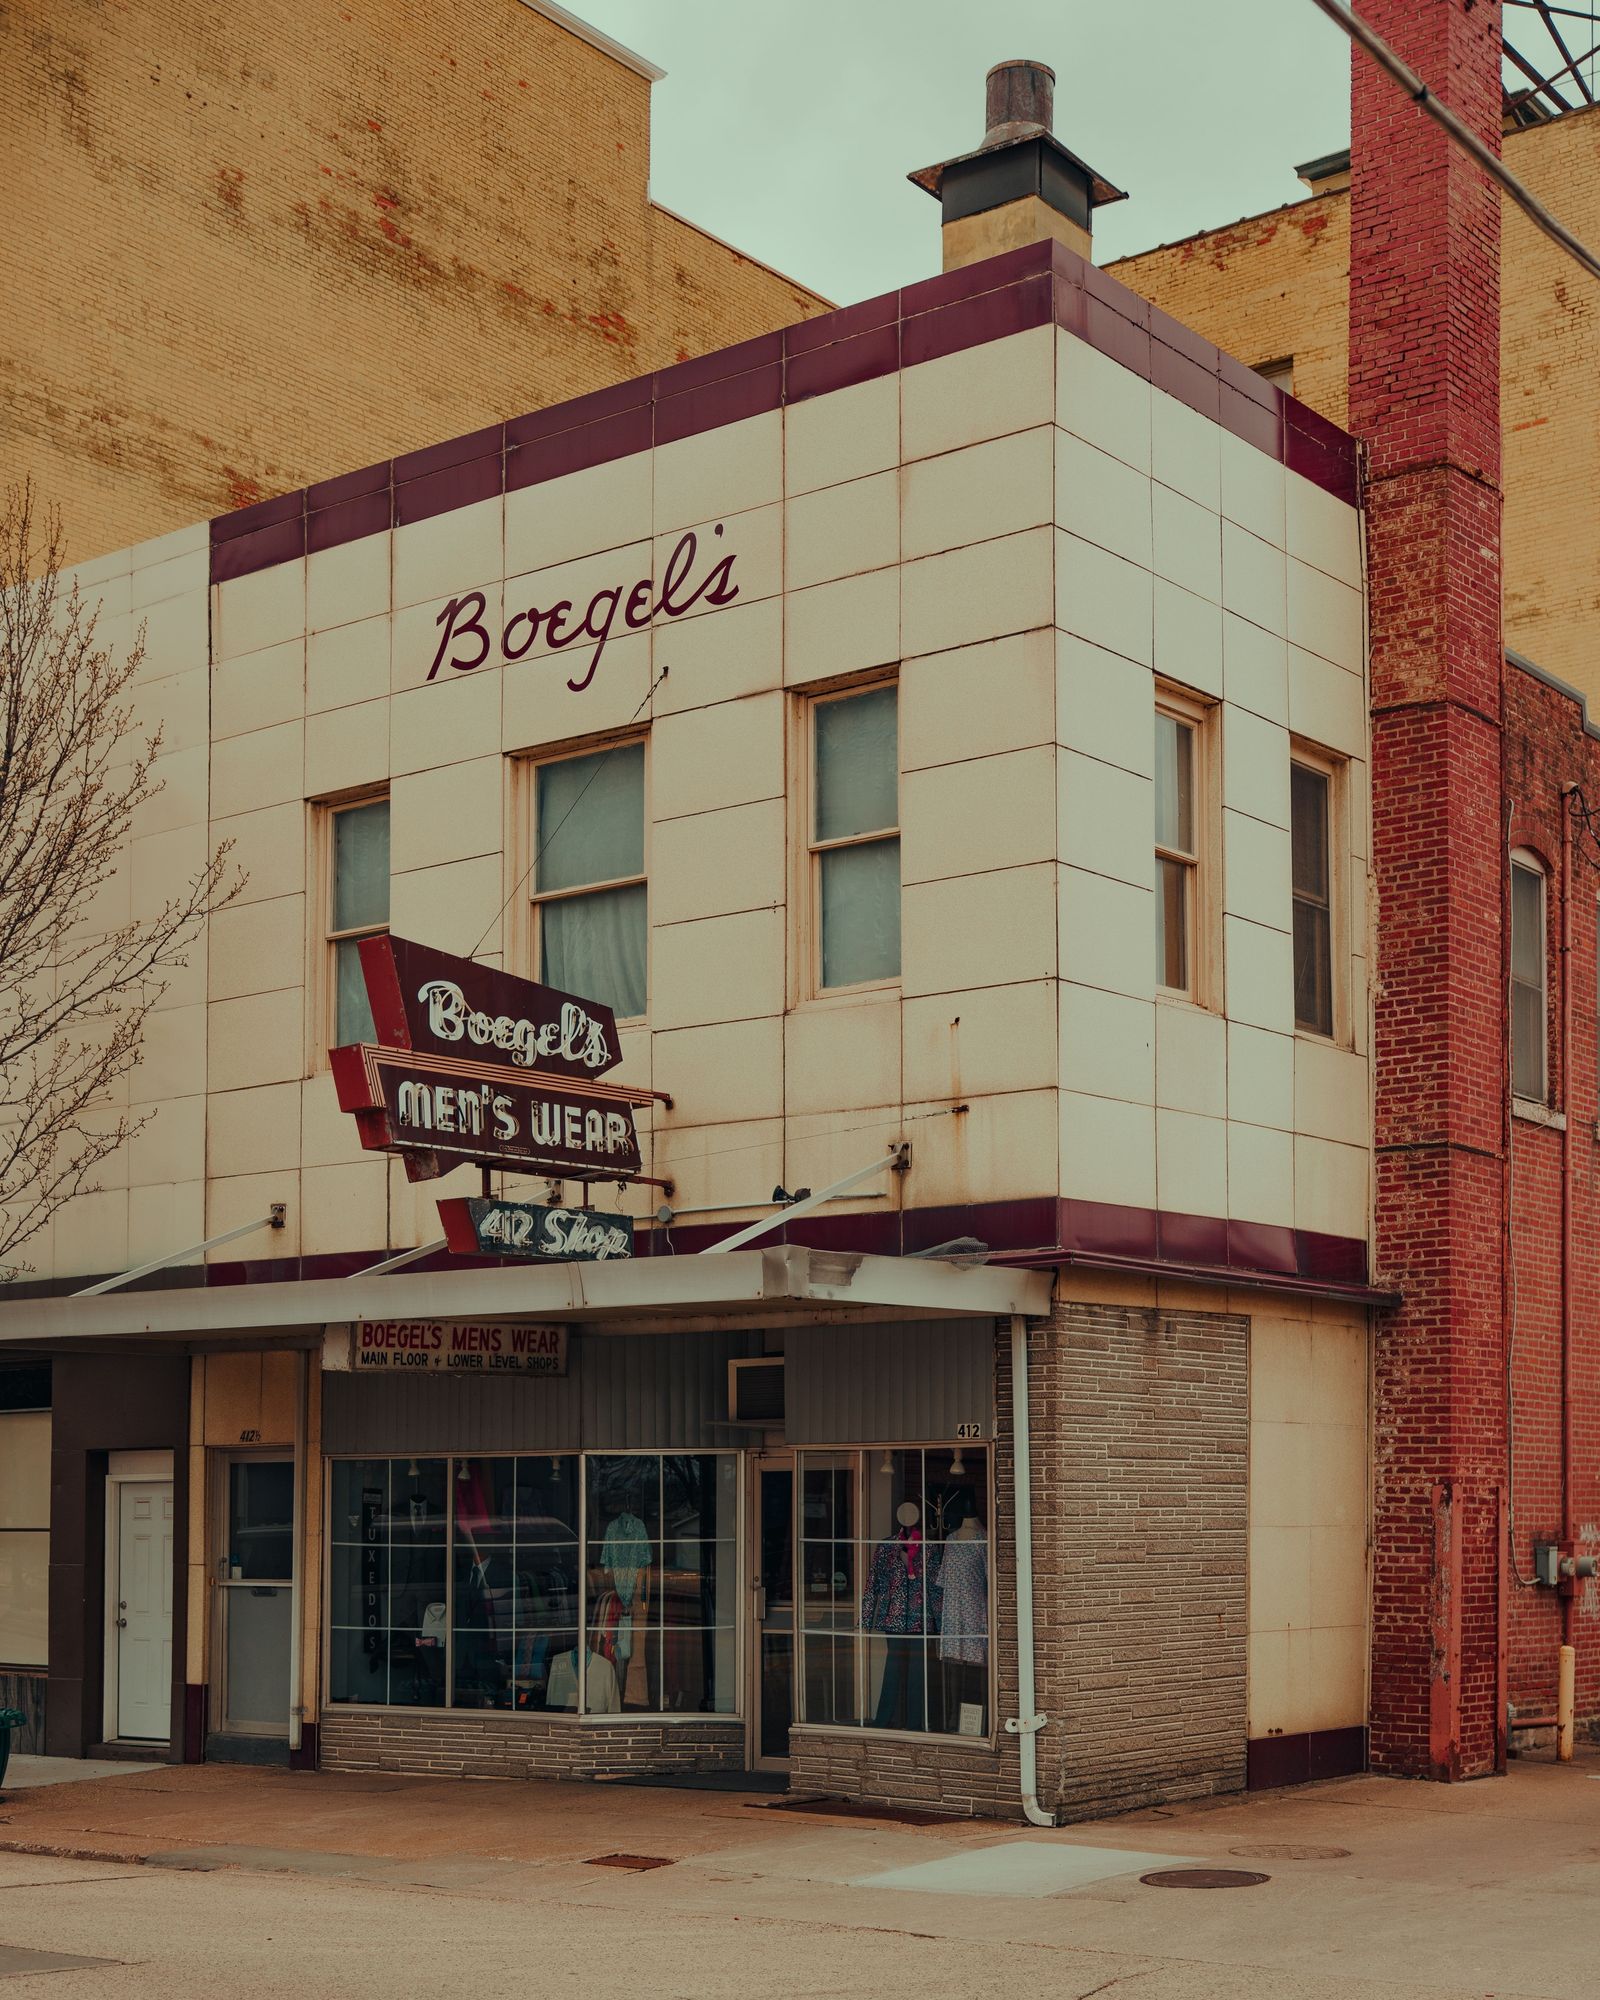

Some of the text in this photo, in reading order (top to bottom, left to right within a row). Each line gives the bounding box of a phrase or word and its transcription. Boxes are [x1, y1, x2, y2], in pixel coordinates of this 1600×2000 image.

[426, 523, 740, 692] Boegel's
[531, 1099, 633, 1155] WEAR
[538, 1208, 631, 1261] Shop
[361, 1322, 560, 1354] BOEGEL'S MENS WEAR
[361, 1352, 388, 1366] MAIN
[393, 1351, 428, 1367] FLOOR
[447, 1353, 483, 1368] LOWER
[489, 1355, 522, 1369] LEVEL
[527, 1356, 559, 1370] SHOPS
[957, 1424, 980, 1438] 412
[367, 1506, 377, 1649] TUXEDOS
